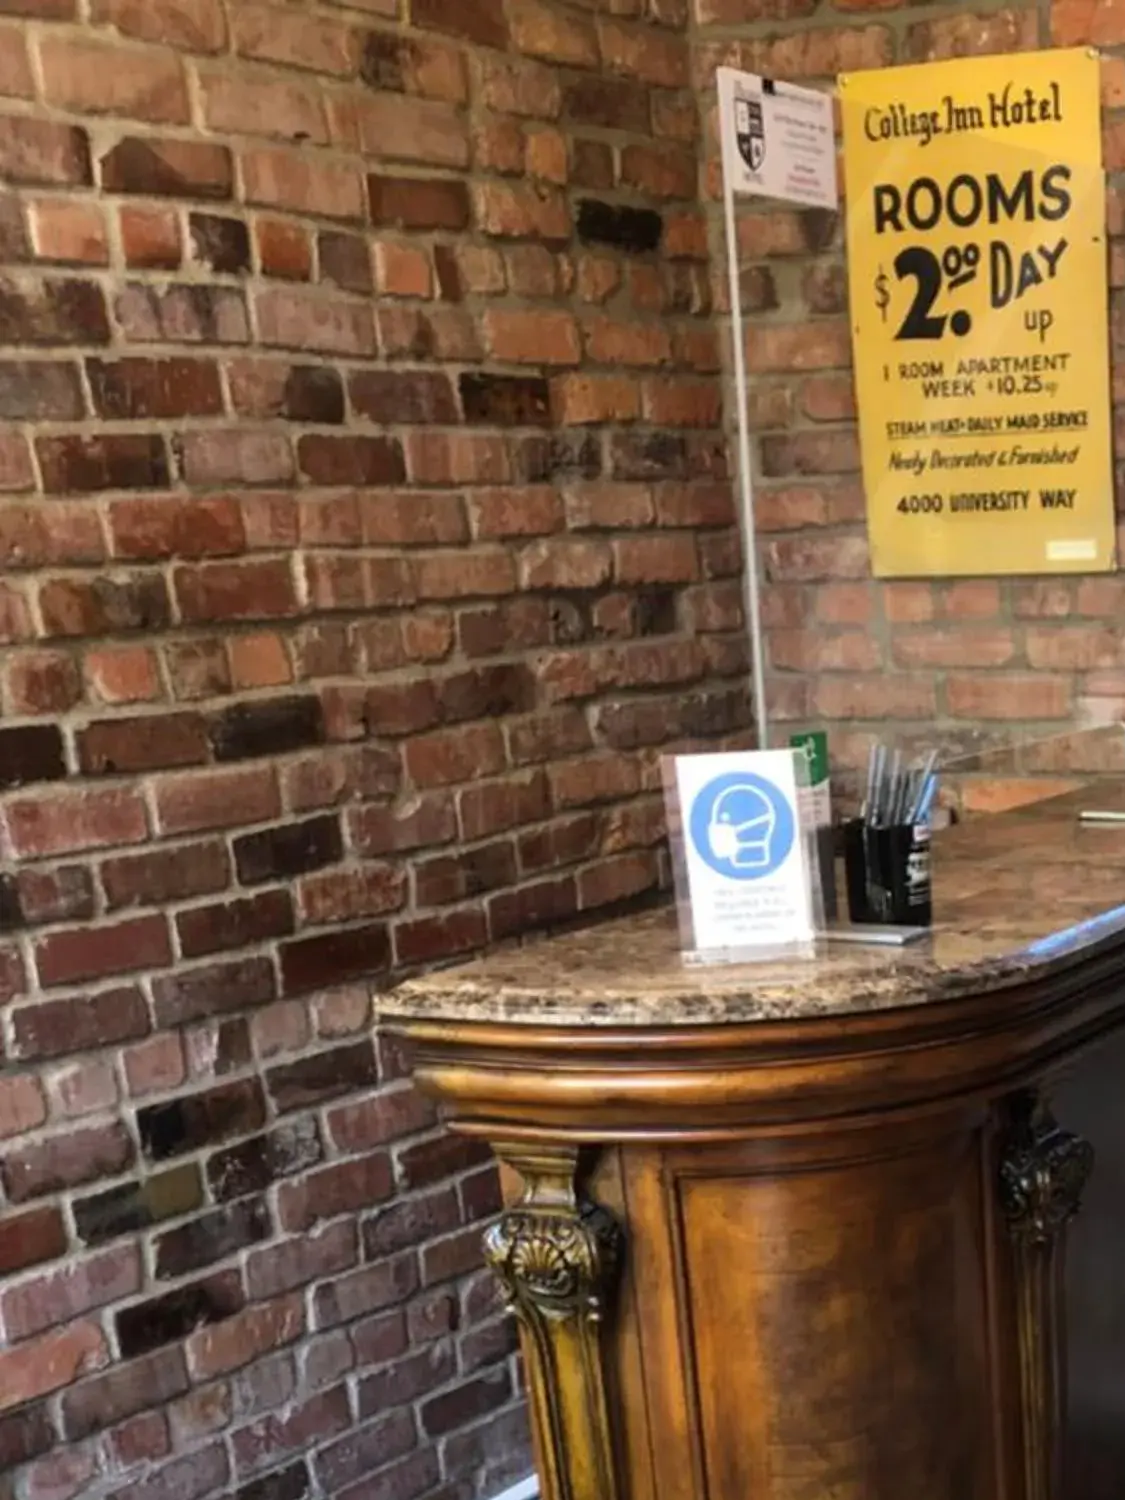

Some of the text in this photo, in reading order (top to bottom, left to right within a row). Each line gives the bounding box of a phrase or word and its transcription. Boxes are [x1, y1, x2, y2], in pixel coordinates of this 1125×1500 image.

[864, 104, 942, 147] College
[943, 96, 984, 134] Inn
[988, 81, 1062, 128] Hotel
[873, 165, 1072, 234] ROOMS
[990, 238, 1068, 309] DAY
[899, 362, 944, 379] ROOM
[957, 353, 1071, 376] APARTMENT
[922, 380, 975, 399] WEEK
[886, 420, 925, 436] STEAM
[1006, 413, 1039, 428] MAID
[1042, 410, 1088, 428] SERVICE
[888, 450, 927, 476] Newly
[930, 448, 996, 470] Decorated
[1008, 445, 1081, 466] Furnished
[897, 489, 1077, 513] 4000 UNIVERSITY WAY
